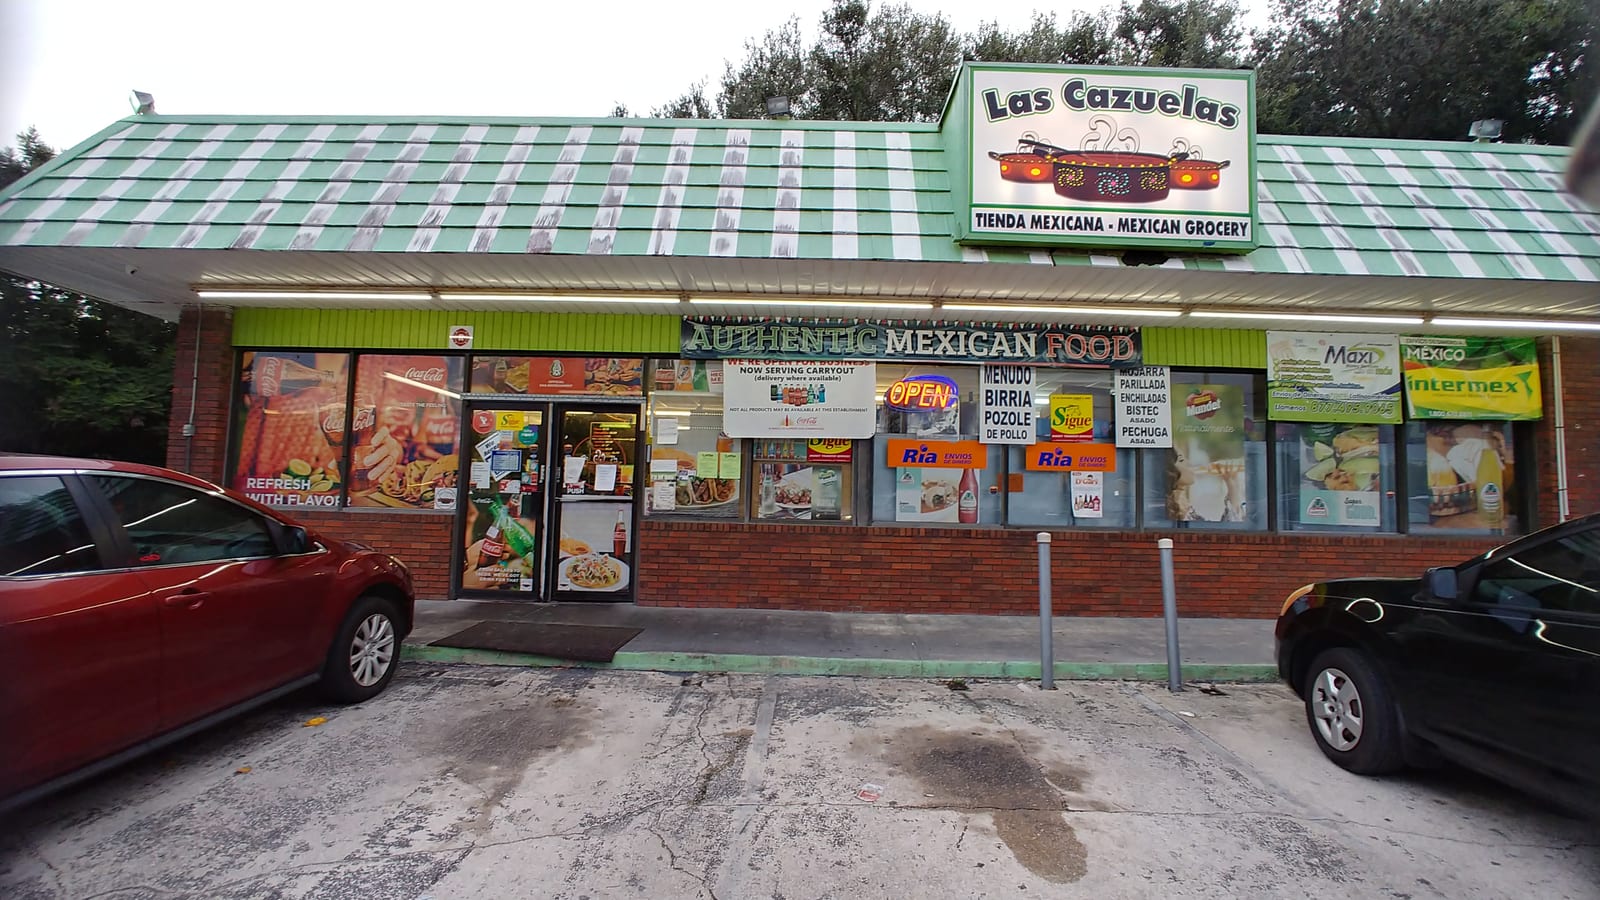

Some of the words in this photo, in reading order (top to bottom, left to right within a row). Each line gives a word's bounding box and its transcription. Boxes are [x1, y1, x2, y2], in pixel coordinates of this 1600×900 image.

[984, 87, 1053, 120] Las
[1063, 79, 1240, 128] Cazuelas
[976, 213, 1026, 230] TIENDA
[1030, 214, 1104, 232] MEXICANA
[1118, 217, 1181, 235] MEXICAN
[1186, 220, 1248, 238] GROCERY
[688, 325, 877, 354] AUTHENTIC
[885, 329, 1037, 358] MEXICAN
[1046, 333, 1134, 361] FOOD
[1324, 345, 1373, 364] Maxi
[1406, 346, 1465, 361] MÉXICO
[727, 358, 760, 366] WERE
[984, 366, 1031, 385] MENUDO
[1120, 367, 1165, 377] MOJARRA
[1120, 379, 1166, 389] PARILLADA
[1408, 376, 1518, 393] intermex
[889, 381, 951, 408] OPEN
[985, 389, 1032, 408] BIRRIA
[1120, 393, 1167, 403] ENCHILADAS
[984, 410, 1031, 426] POZOLE
[1052, 406, 1092, 430] Sigue
[1126, 405, 1159, 416] BISTEC
[986, 429, 997, 439] DE
[1000, 429, 1028, 439] POLLO
[1122, 426, 1168, 437] PECHUGA
[902, 444, 938, 464] Ria
[1038, 447, 1072, 467] Ria
[246, 477, 311, 490] REFRESH
[246, 493, 284, 506] WITH
